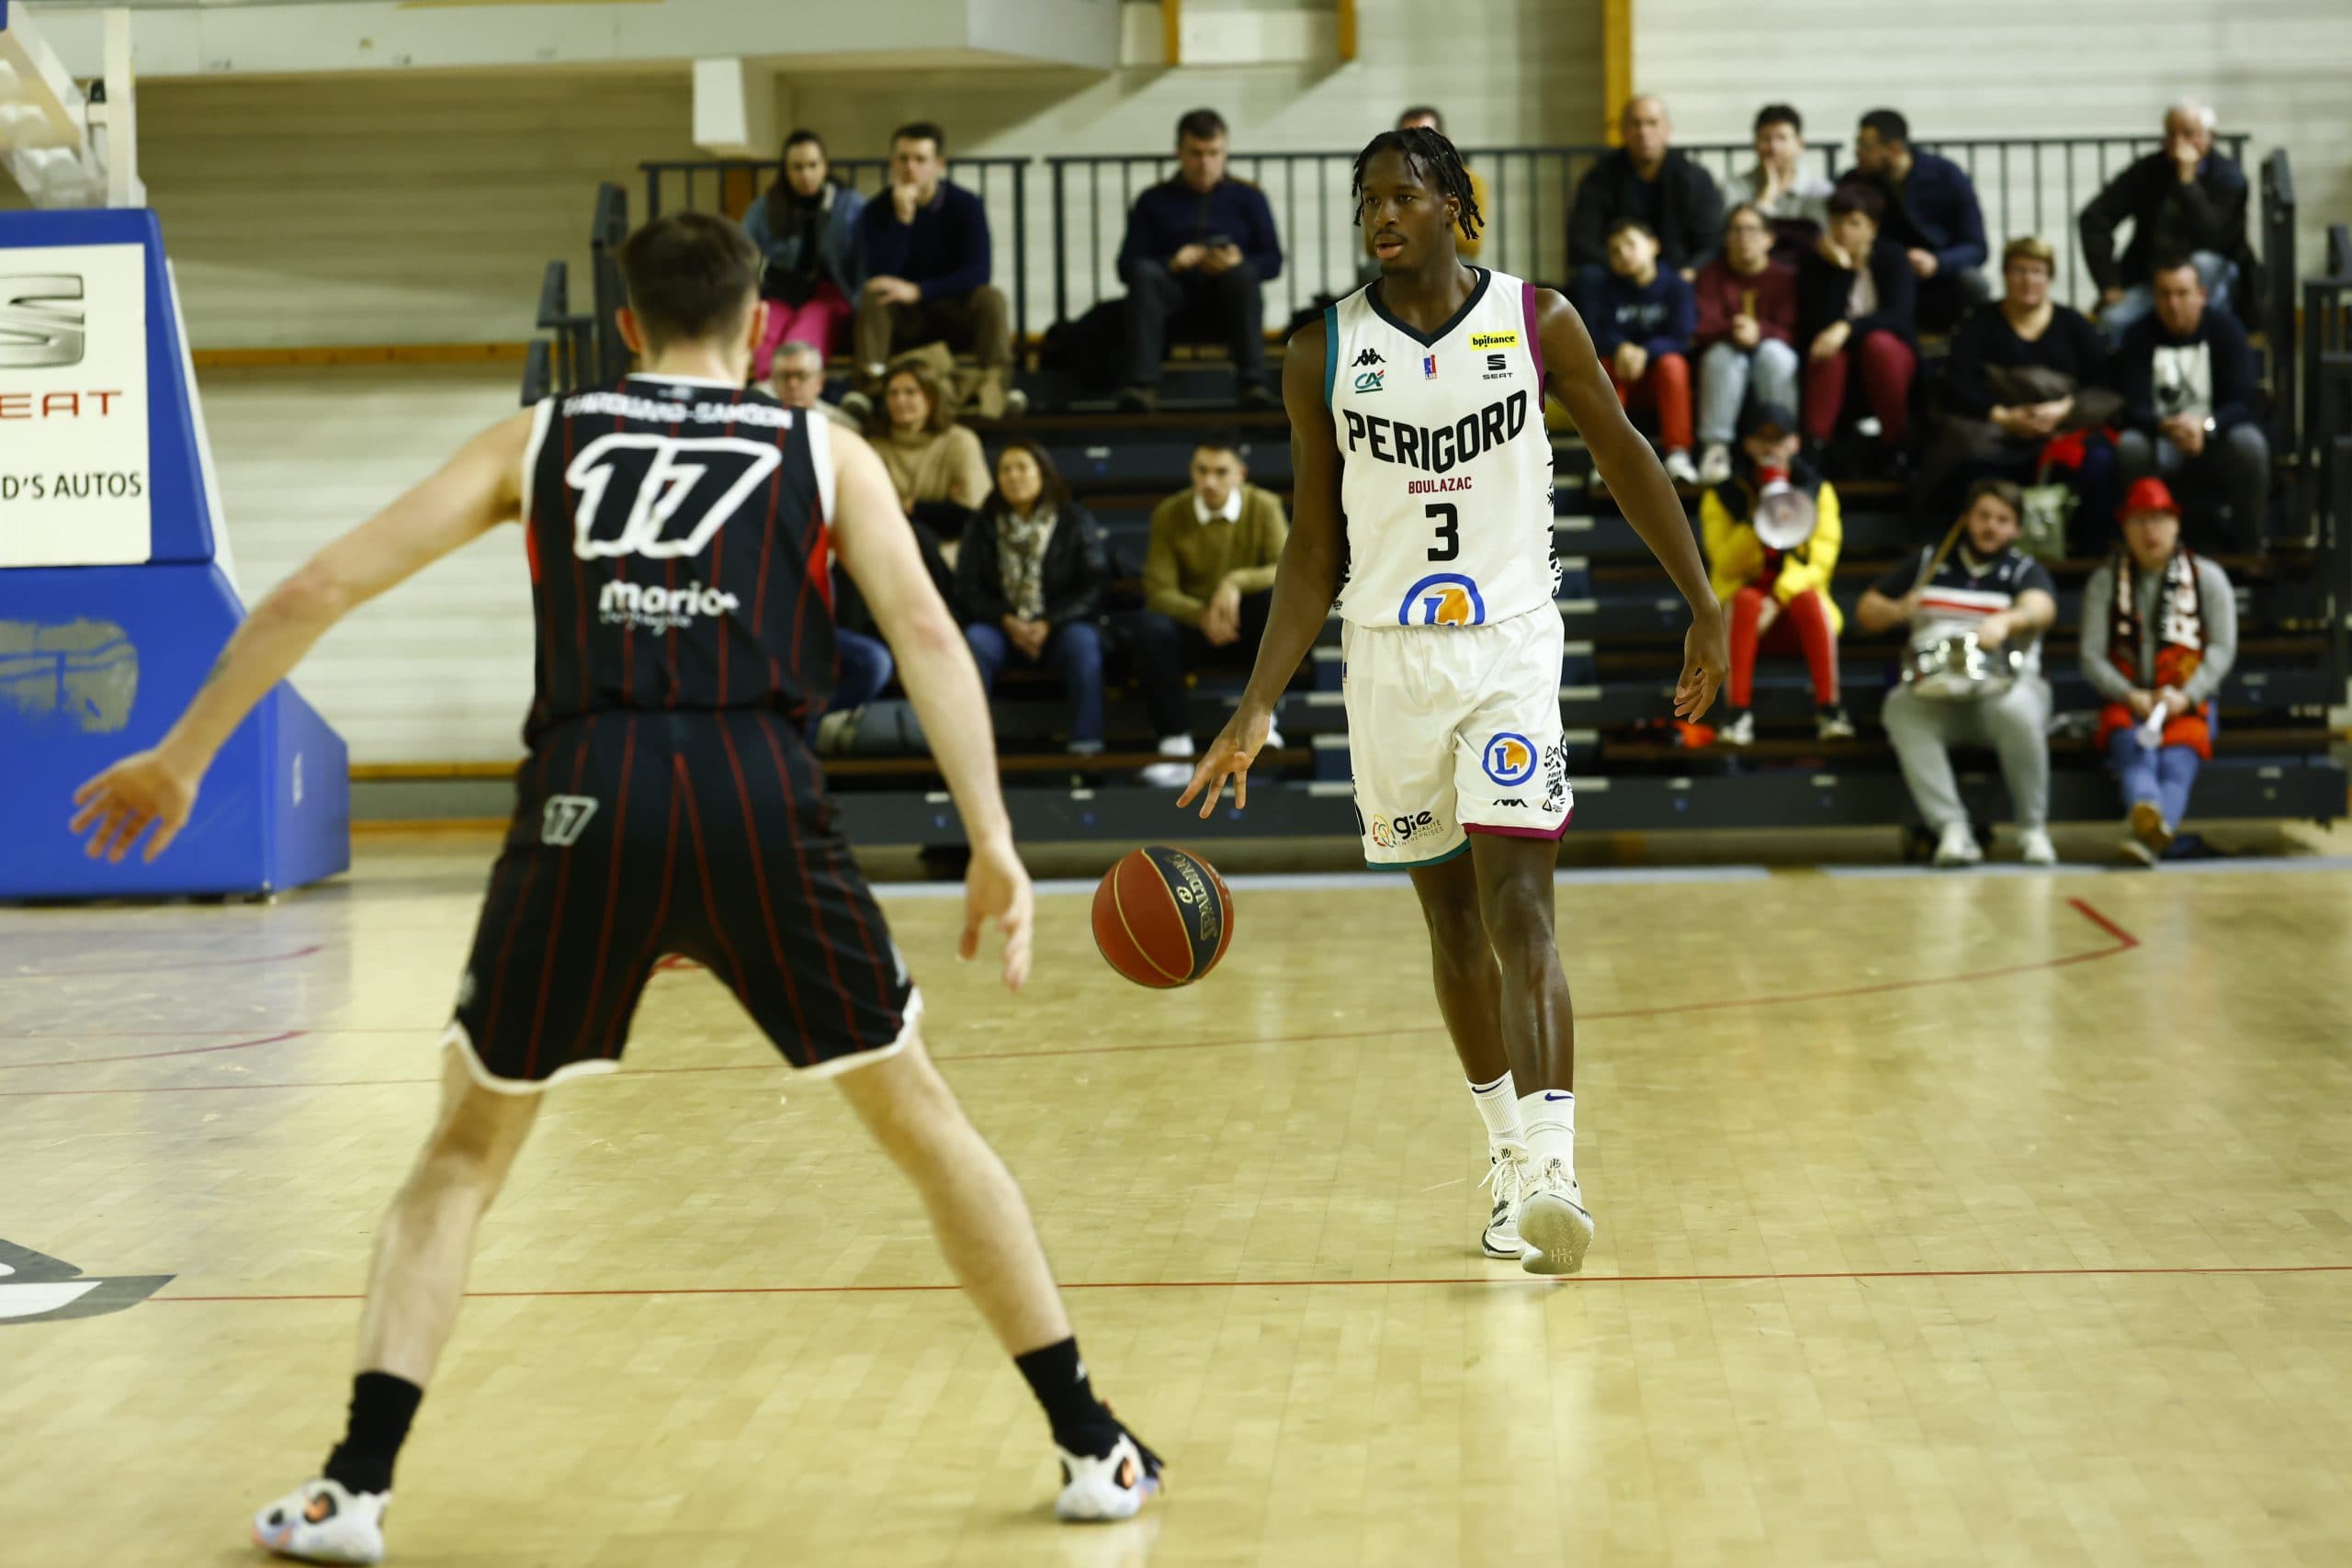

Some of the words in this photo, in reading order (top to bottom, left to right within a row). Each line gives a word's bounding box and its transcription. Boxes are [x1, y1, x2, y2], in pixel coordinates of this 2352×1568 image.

[1472, 334, 1516, 348] bpifrance
[1482, 372, 1514, 380] SEAT
[1342, 389, 1527, 474] PERIGORD
[53, 471, 142, 499] AUTOS
[565, 433, 782, 561] 17
[1408, 477, 1472, 494] BOULAZAC
[1425, 502, 1459, 562] 3
[540, 794, 600, 847] 17
[1393, 810, 1433, 840] gie
